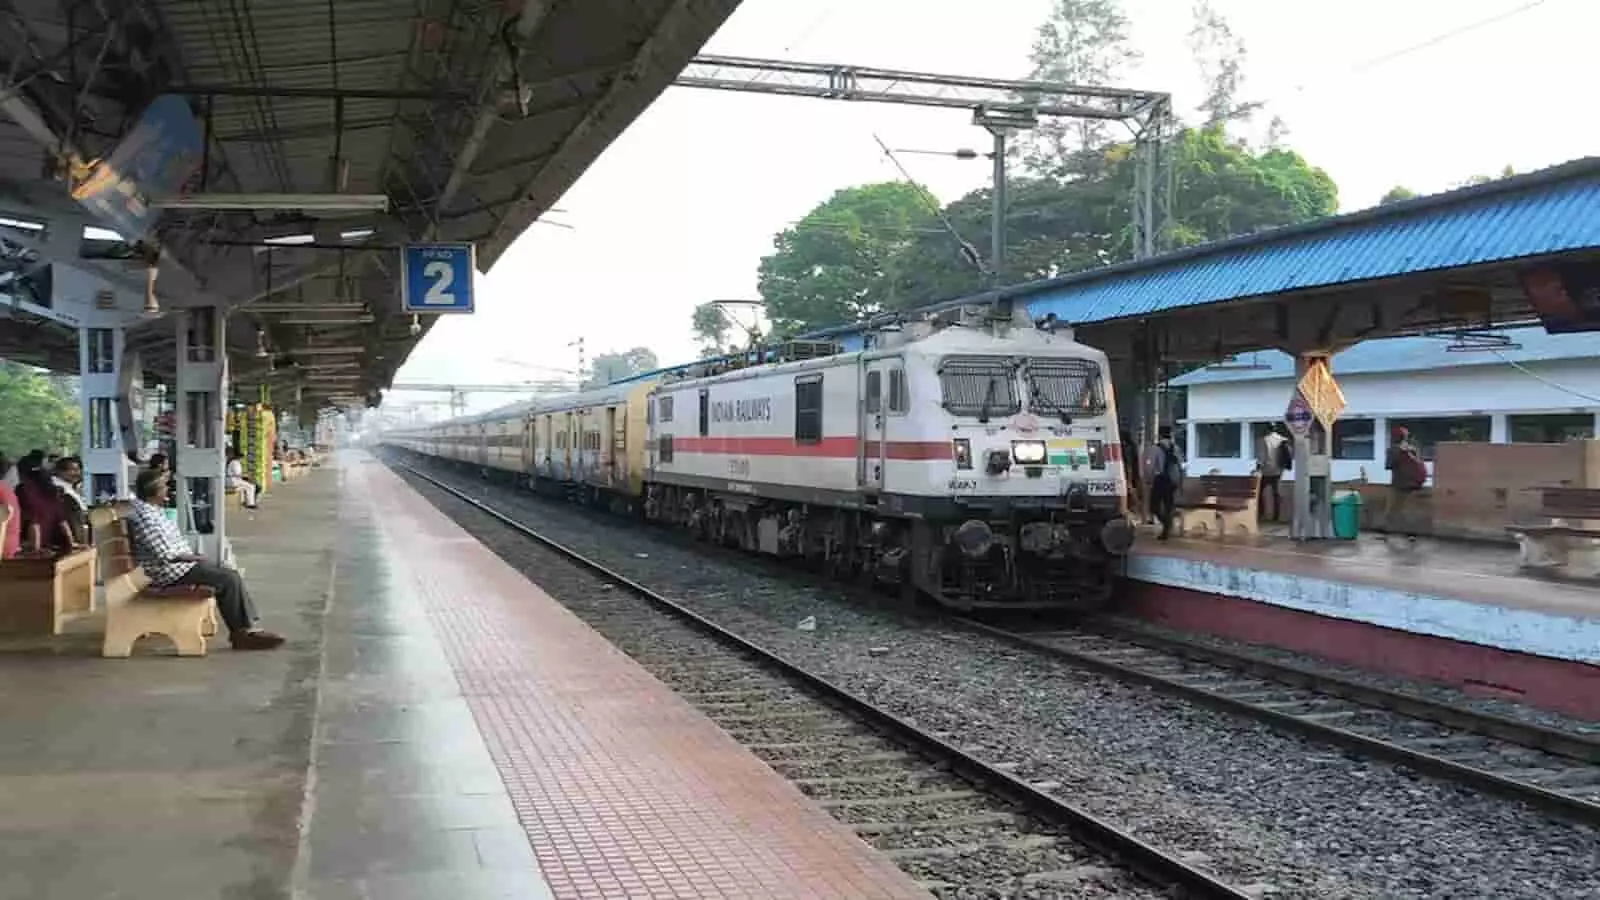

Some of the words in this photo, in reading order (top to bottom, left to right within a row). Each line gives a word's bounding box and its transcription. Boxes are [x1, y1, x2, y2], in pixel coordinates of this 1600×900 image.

[423, 261, 455, 304] 2
[711, 400, 735, 423] INDIAN
[736, 397, 771, 422] RAILWAYS
